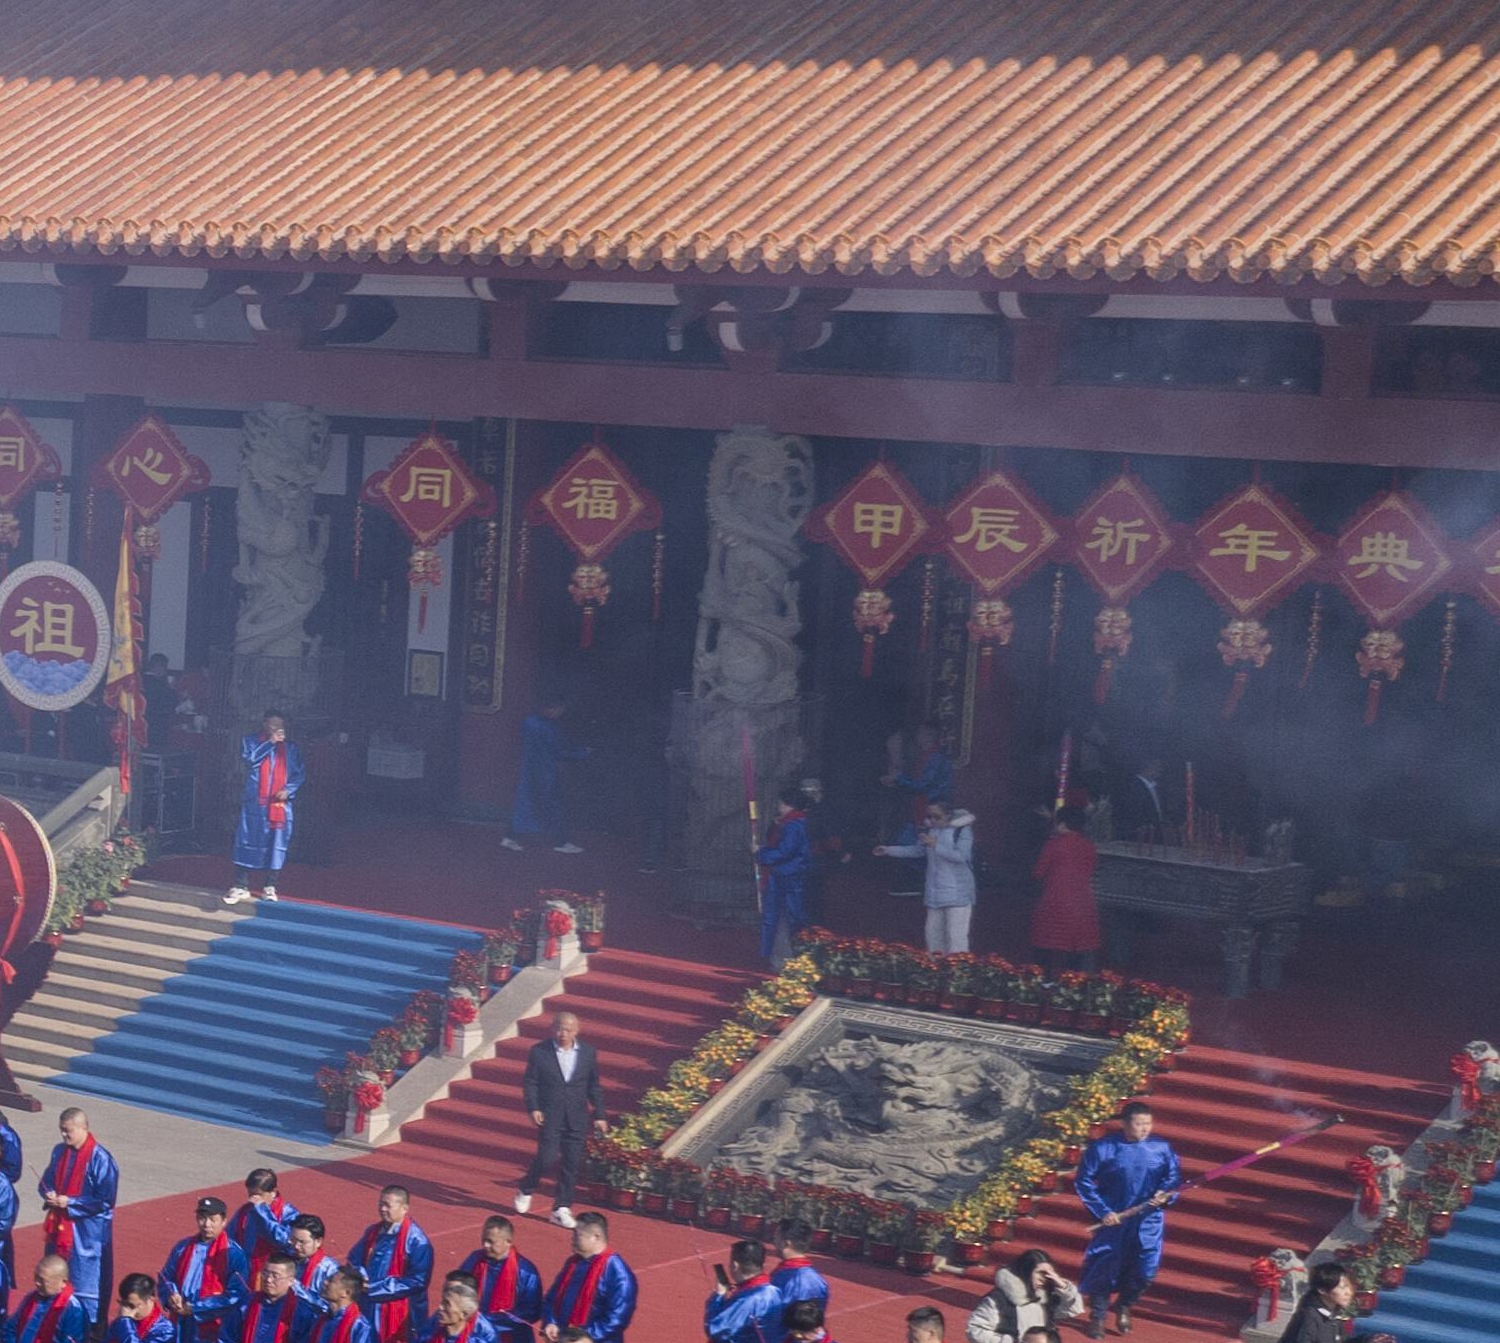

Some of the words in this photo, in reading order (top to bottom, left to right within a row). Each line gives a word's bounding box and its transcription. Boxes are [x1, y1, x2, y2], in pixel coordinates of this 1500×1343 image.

[121, 447, 171, 485] 心
[400, 466, 452, 508] 同
[564, 478, 619, 520] 福
[854, 502, 903, 548] 甲
[956, 509, 1027, 555] 辰
[1086, 518, 1150, 564] 祈
[1217, 524, 1289, 572] 年
[1348, 531, 1424, 583] 典
[13, 598, 84, 656] 祖
